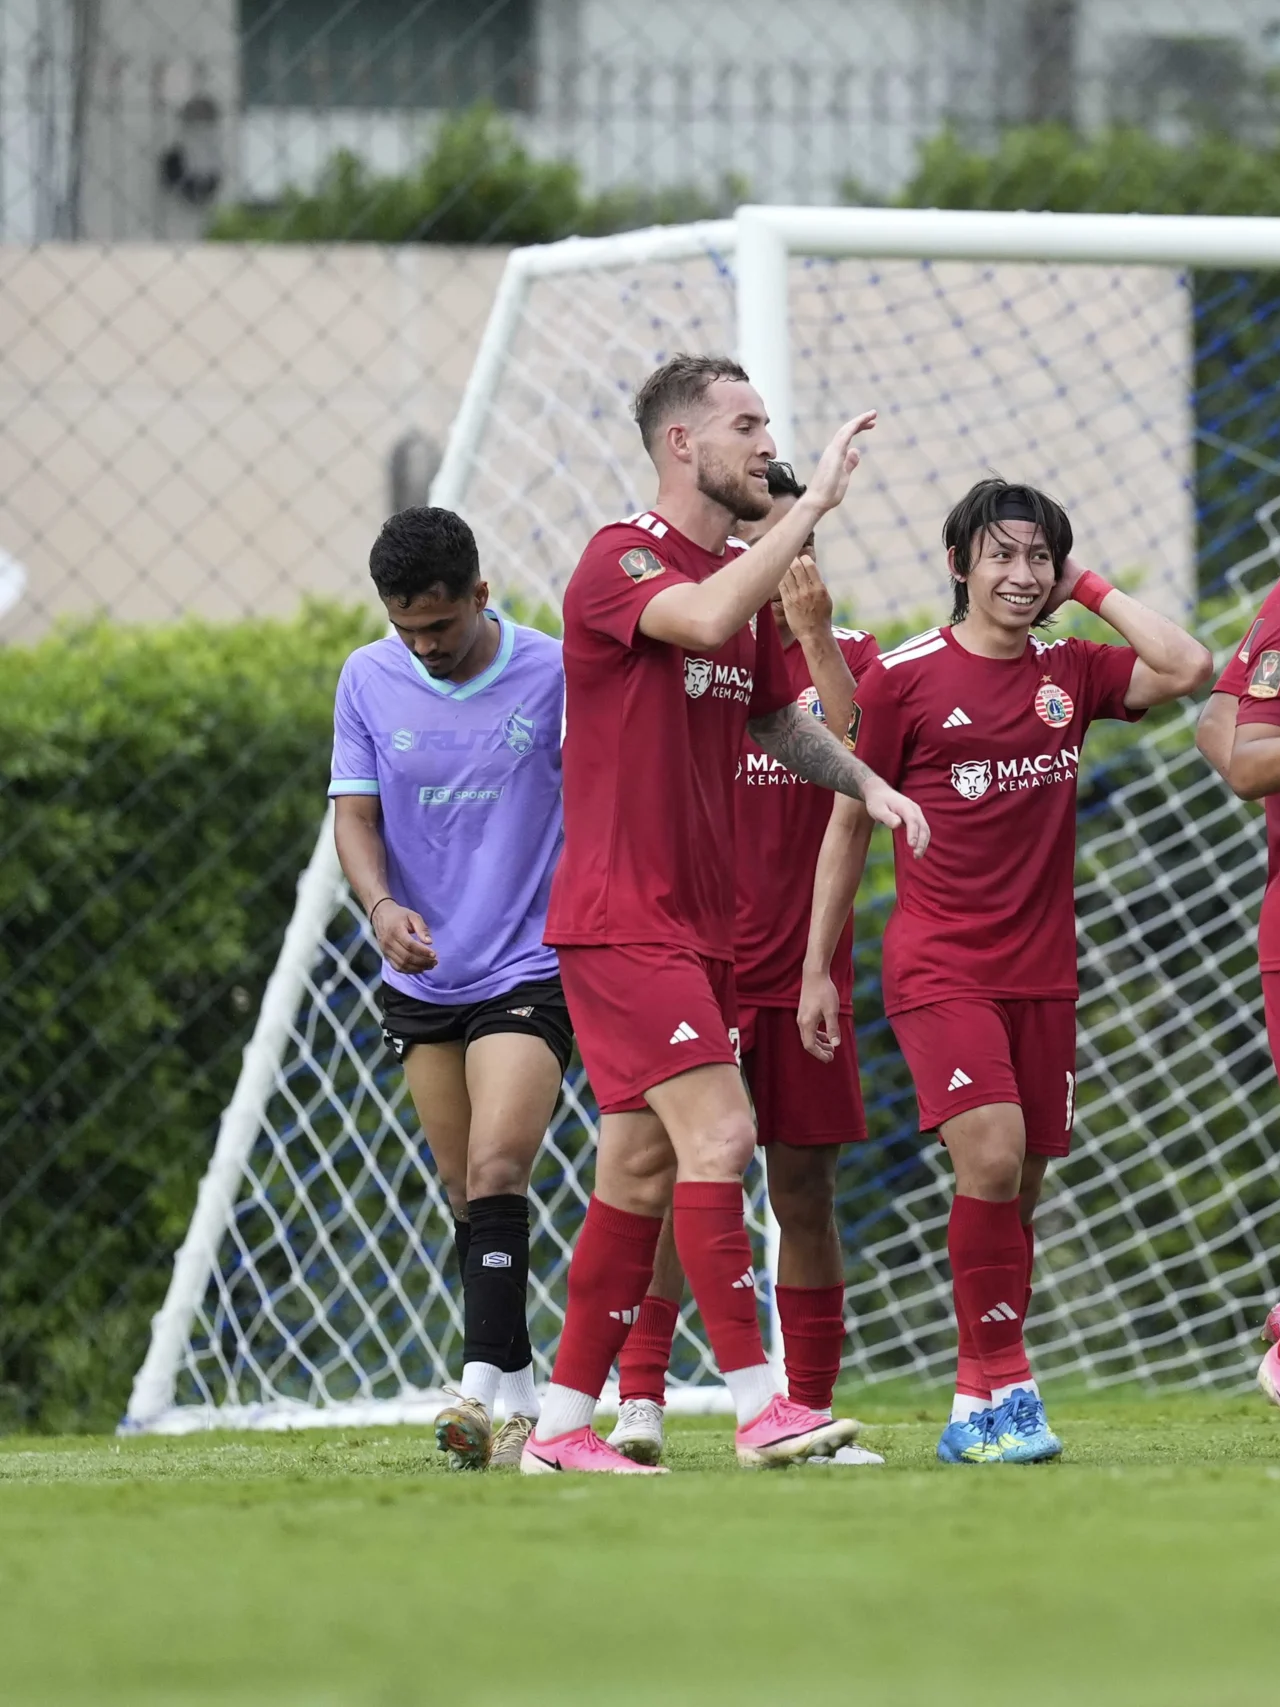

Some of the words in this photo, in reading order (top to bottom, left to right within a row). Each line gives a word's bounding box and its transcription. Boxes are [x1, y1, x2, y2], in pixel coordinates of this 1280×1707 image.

[996, 745, 1079, 780] MACAN
[421, 788, 447, 801] BG
[454, 790, 500, 800] SPORTS
